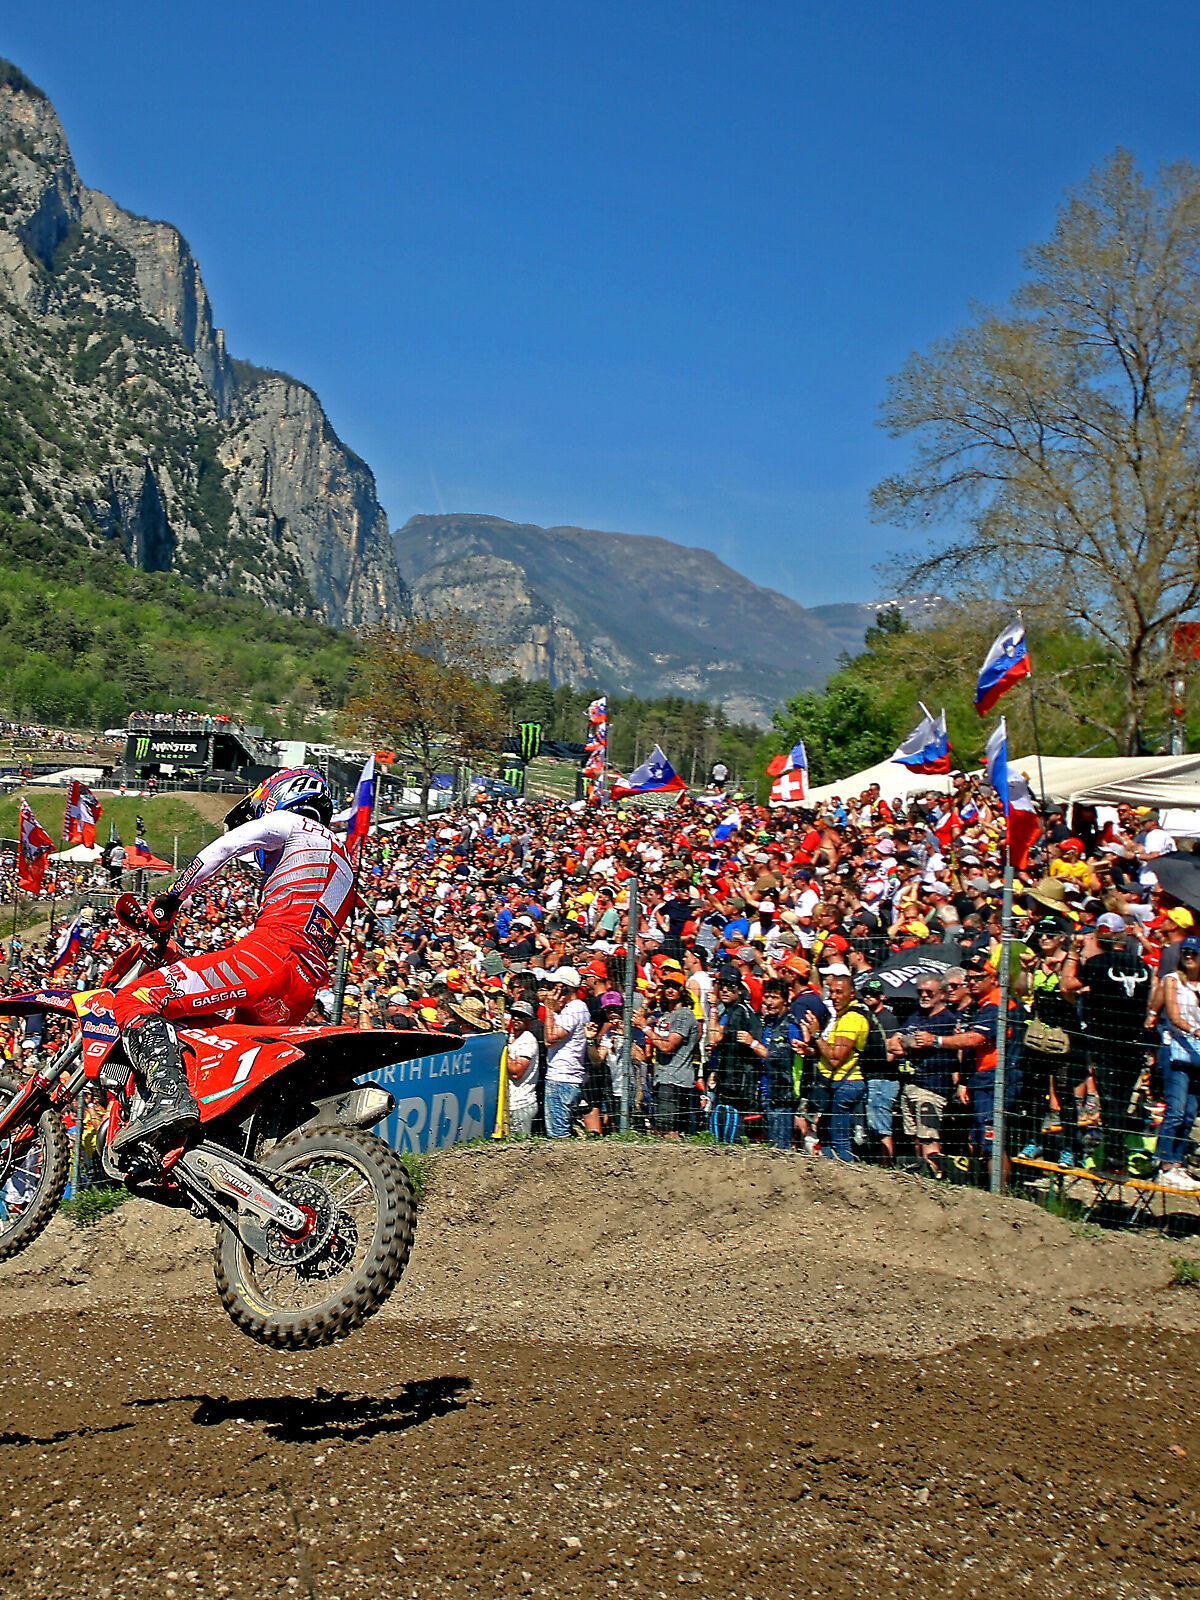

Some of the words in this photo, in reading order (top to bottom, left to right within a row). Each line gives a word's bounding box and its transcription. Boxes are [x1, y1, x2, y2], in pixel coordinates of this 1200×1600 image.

[151, 741, 197, 752] MONSTER
[192, 988, 248, 1007] GASGAS
[180, 1028, 239, 1051] GAS
[232, 1046, 262, 1085] 1
[367, 1057, 422, 1083] ORTH
[429, 1052, 473, 1079] LAKE
